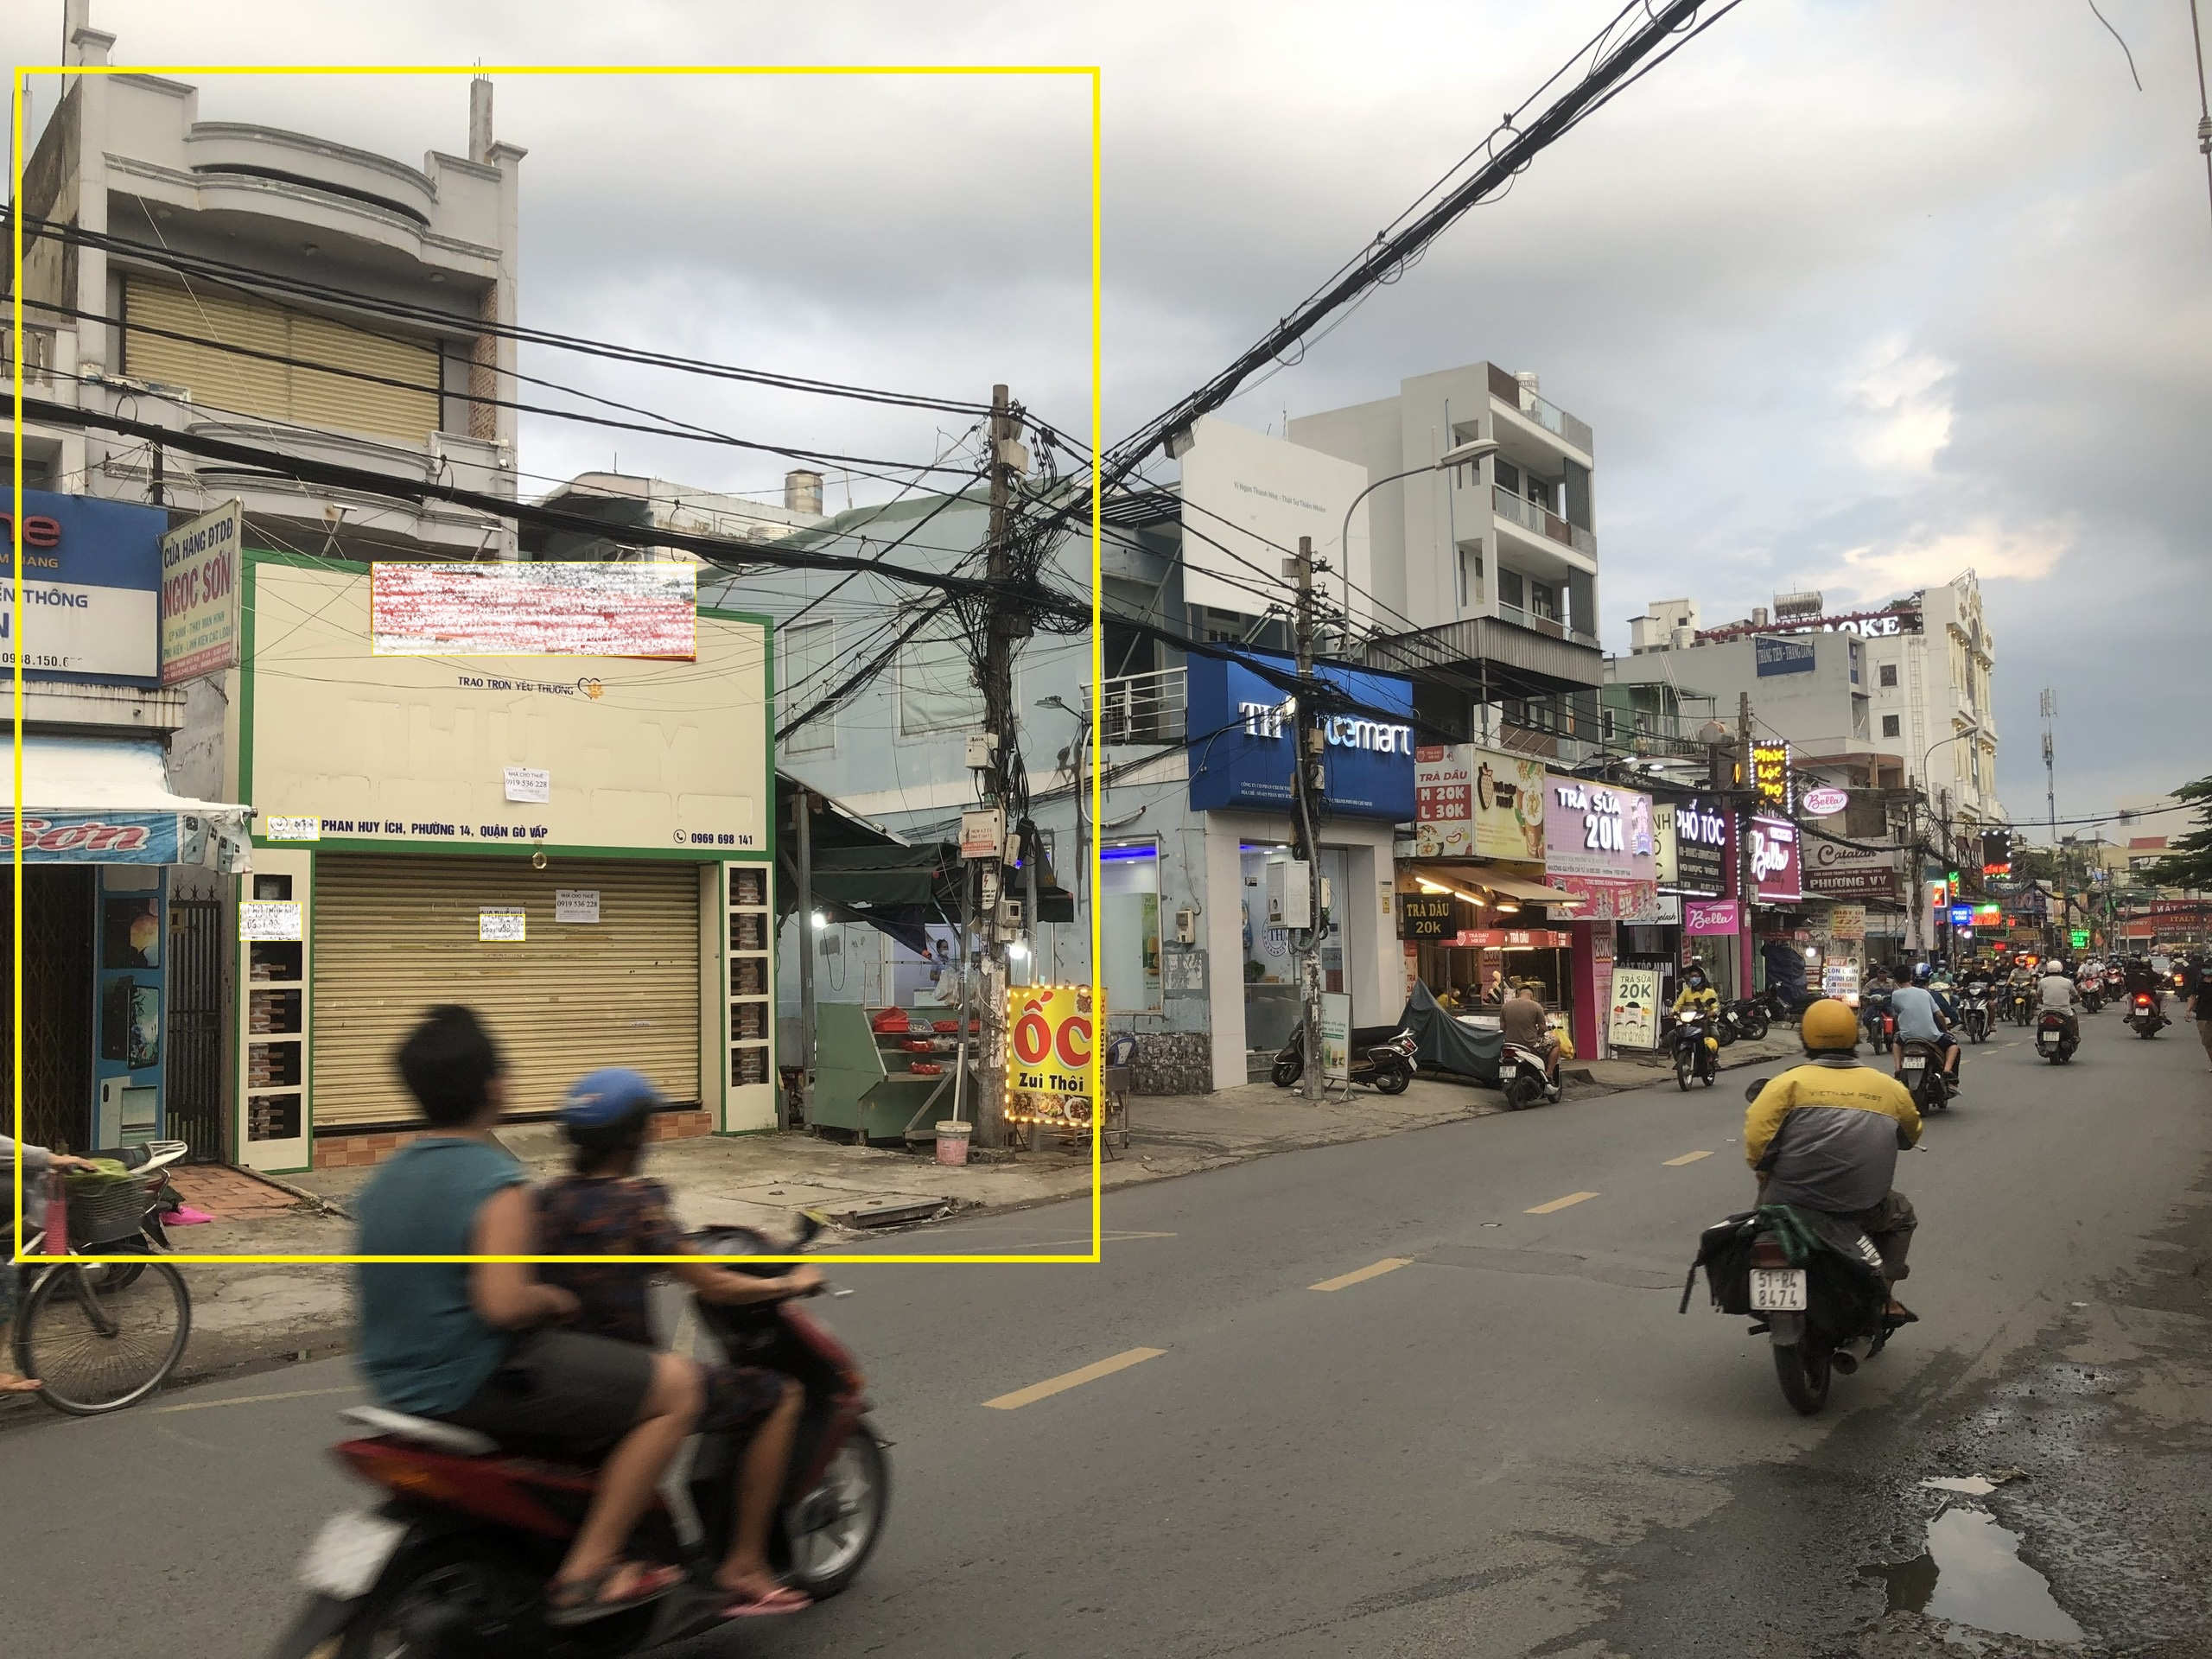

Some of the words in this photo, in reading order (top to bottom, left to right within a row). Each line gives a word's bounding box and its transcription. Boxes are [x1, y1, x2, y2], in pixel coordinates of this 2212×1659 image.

[164, 537, 181, 569] CỬA
[183, 529, 206, 558] HÀNG
[22, 554, 59, 568] ÀNG
[163, 568, 199, 620] NGỌC
[202, 549, 232, 604] SƠN
[22, 588, 88, 608] THÔNG
[458, 677, 483, 687] TRAO
[486, 679, 512, 690] TRỌN
[1238, 702, 1283, 739] TH
[1312, 714, 1411, 756] uemart
[1419, 770, 1440, 782] TRÀ
[1443, 769, 1467, 781] DÂU
[1421, 788, 1431, 801] M
[1436, 786, 1465, 801] 20K
[1557, 785, 1588, 810] TRÀ
[1592, 790, 1622, 815] SỮA
[1808, 794, 1843, 810] Bella
[1421, 805, 1431, 819] L
[1436, 804, 1465, 818] 30K
[321, 820, 353, 832] PHAN
[358, 821, 380, 833] HUY
[384, 819, 406, 835] ÍCH,
[411, 821, 454, 836] PHƯỜNG
[459, 825, 474, 837] 14,
[480, 823, 508, 839] QUẬN
[512, 823, 526, 838] GÒ
[530, 823, 548, 838] VẤP
[1586, 814, 1624, 851] 20K
[1701, 807, 1726, 846] TÓC
[691, 833, 714, 843] 0969
[717, 834, 734, 844] 698
[738, 835, 753, 845] 141
[1809, 877, 1865, 889] PHƯƠNG
[1869, 875, 1887, 886] VY
[1406, 899, 1427, 917] TRÀ
[1429, 899, 1450, 917] DÂU
[1650, 912, 1676, 924] yelash
[1689, 911, 1733, 929] Bella
[1415, 921, 1441, 934] 20k
[1510, 931, 1519, 944] TRÀ
[1519, 931, 1529, 943] DÂU
[1595, 938, 1610, 957] 20K
[1620, 974, 1635, 983] TRÀ
[1637, 974, 1651, 983] SỮA
[1619, 983, 1651, 999] 20K
[1012, 990, 1093, 1071] ỐC
[1019, 1072, 1044, 1088] Zui
[1049, 1075, 1084, 1092] Thôi
[1859, 1092, 1882, 1102] POST
[1758, 1289, 1797, 1306] 8474
